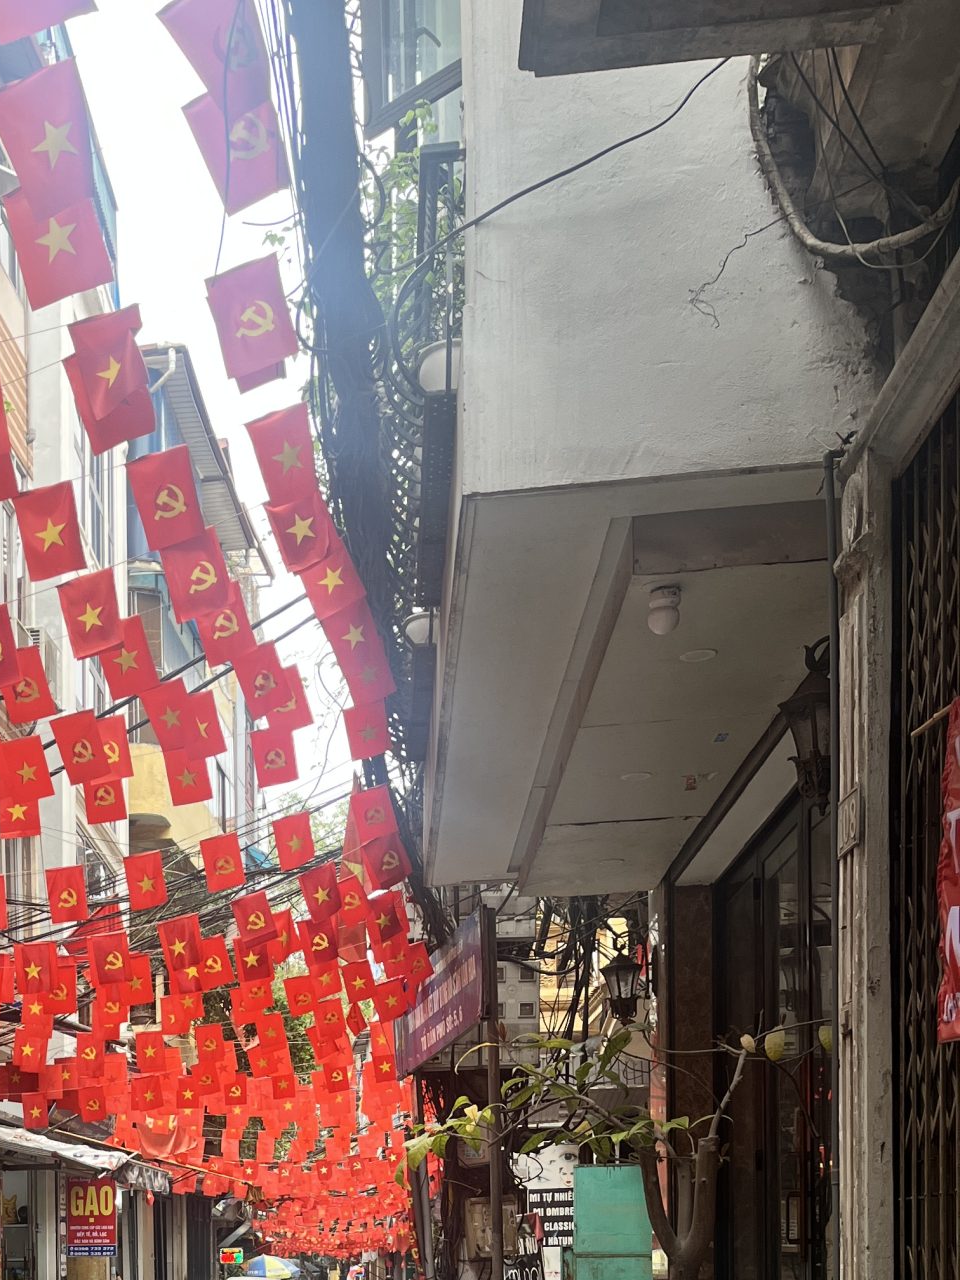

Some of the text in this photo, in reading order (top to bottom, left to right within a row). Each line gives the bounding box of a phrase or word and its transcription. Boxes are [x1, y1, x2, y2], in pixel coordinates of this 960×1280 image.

[70, 1185, 114, 1223] GẠO
[529, 1193, 541, 1203] MI
[553, 1190, 575, 1202] NHIÊ
